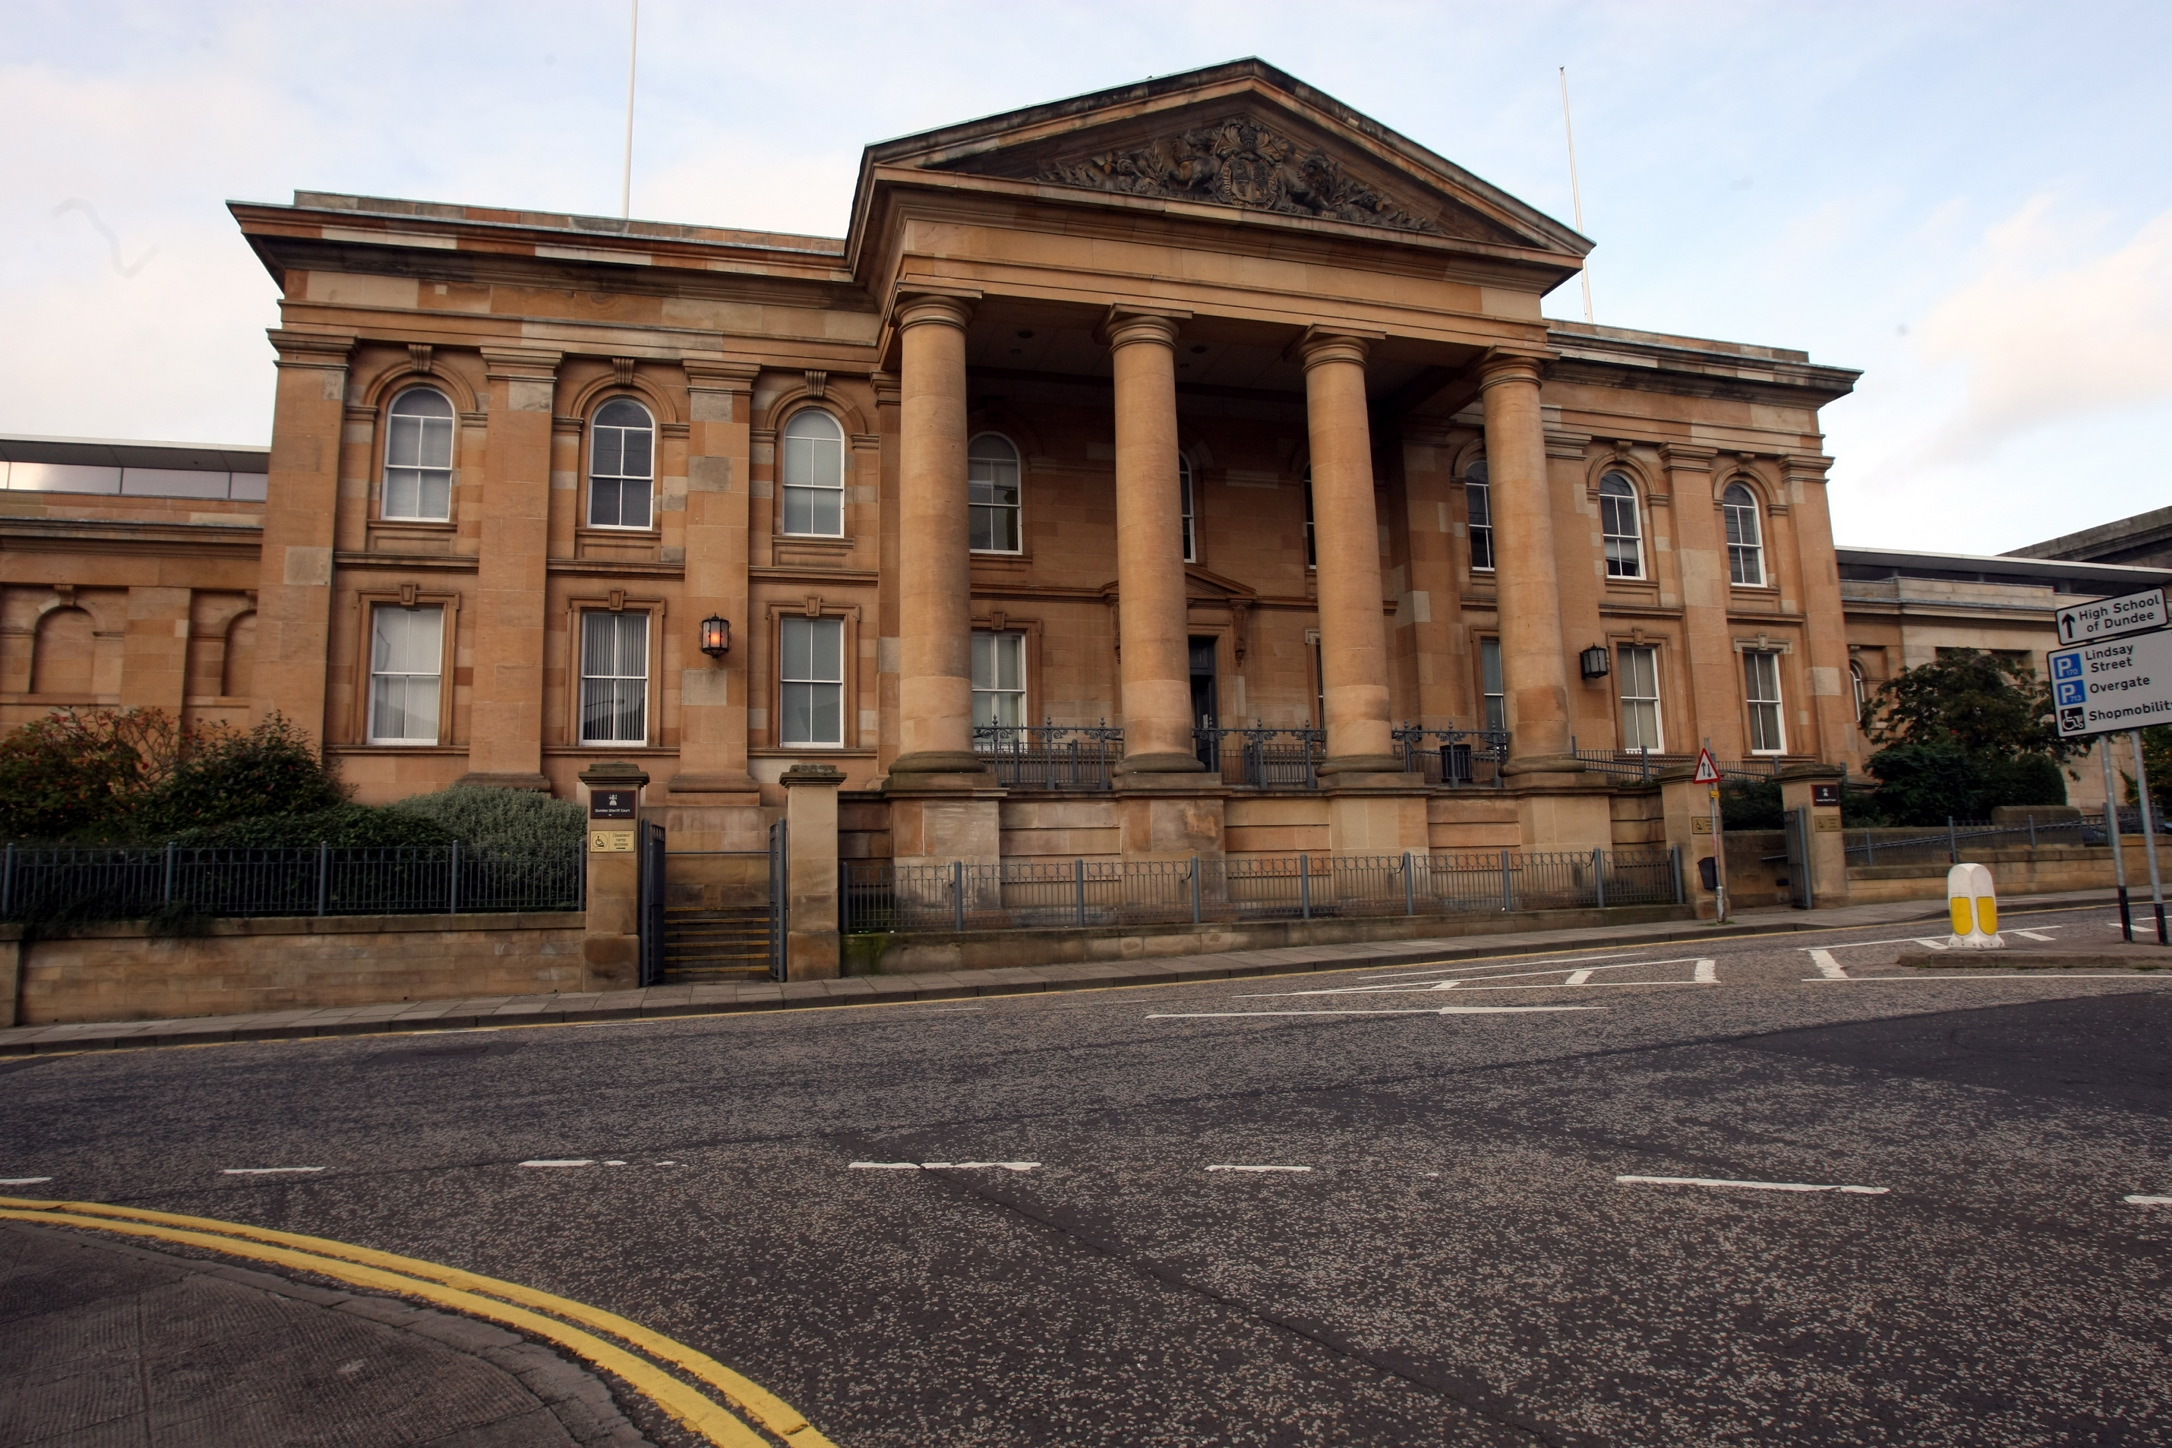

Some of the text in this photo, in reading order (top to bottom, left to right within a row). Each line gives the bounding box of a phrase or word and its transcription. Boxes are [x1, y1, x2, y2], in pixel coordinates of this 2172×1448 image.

[2079, 595, 2160, 621] High School
[2086, 612, 2155, 633] of Dundee
[2085, 644, 2134, 661] Lindsay
[2056, 657, 2072, 678] P
[2090, 657, 2133, 673] Street
[2060, 683, 2076, 704] P
[2089, 676, 2151, 694] Overgate
[2089, 701, 2172, 721] Shopmobilit
